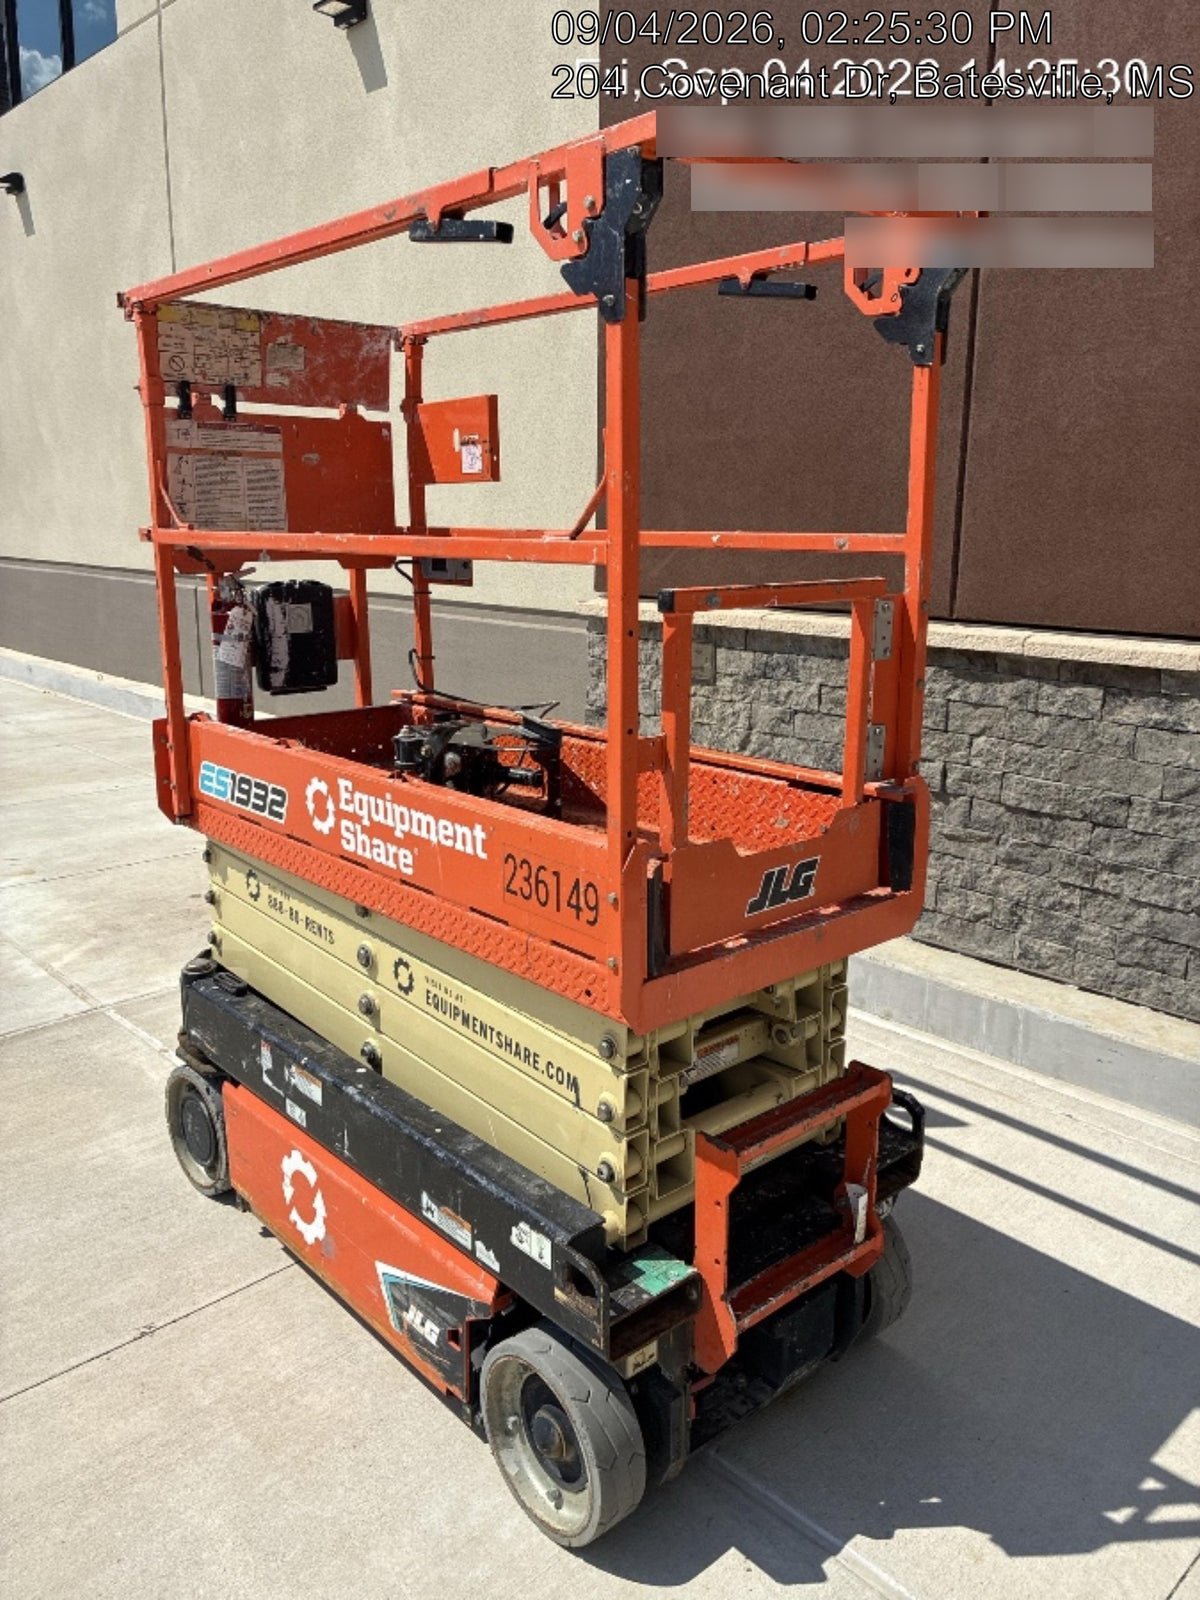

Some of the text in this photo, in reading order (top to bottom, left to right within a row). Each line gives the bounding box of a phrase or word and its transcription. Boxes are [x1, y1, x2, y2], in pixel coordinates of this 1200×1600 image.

[199, 760, 288, 824] ES1932
[337, 778, 488, 860] Equipment
[340, 819, 414, 876] Share
[504, 853, 599, 927] 236149
[745, 855, 821, 918] JLG
[425, 988, 581, 1096] EQUIPMENTSHARE.COM
